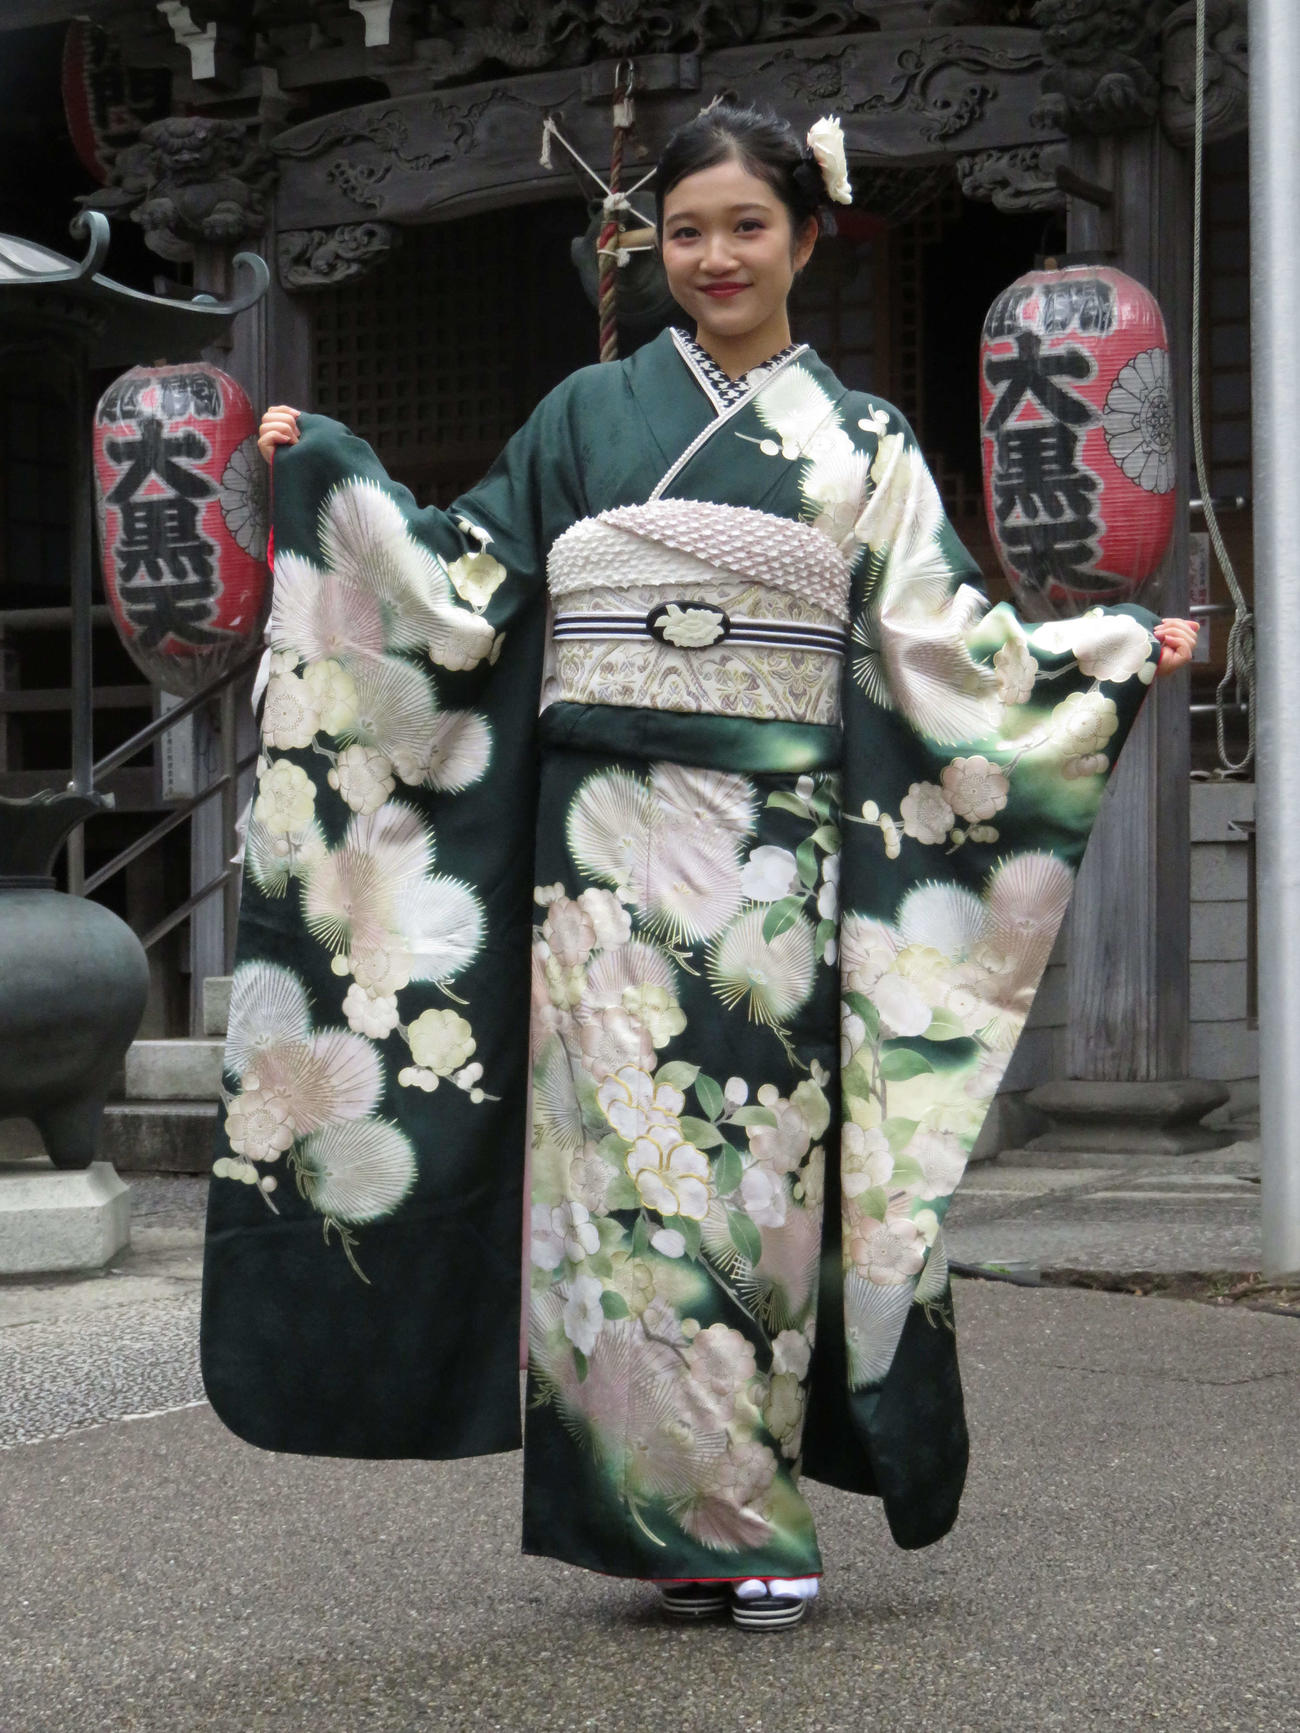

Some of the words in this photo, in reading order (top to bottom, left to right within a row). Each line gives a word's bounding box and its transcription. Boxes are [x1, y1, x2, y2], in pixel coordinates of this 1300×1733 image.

[105, 417, 240, 649] 大黒天
[984, 331, 1129, 593] 大黒天
